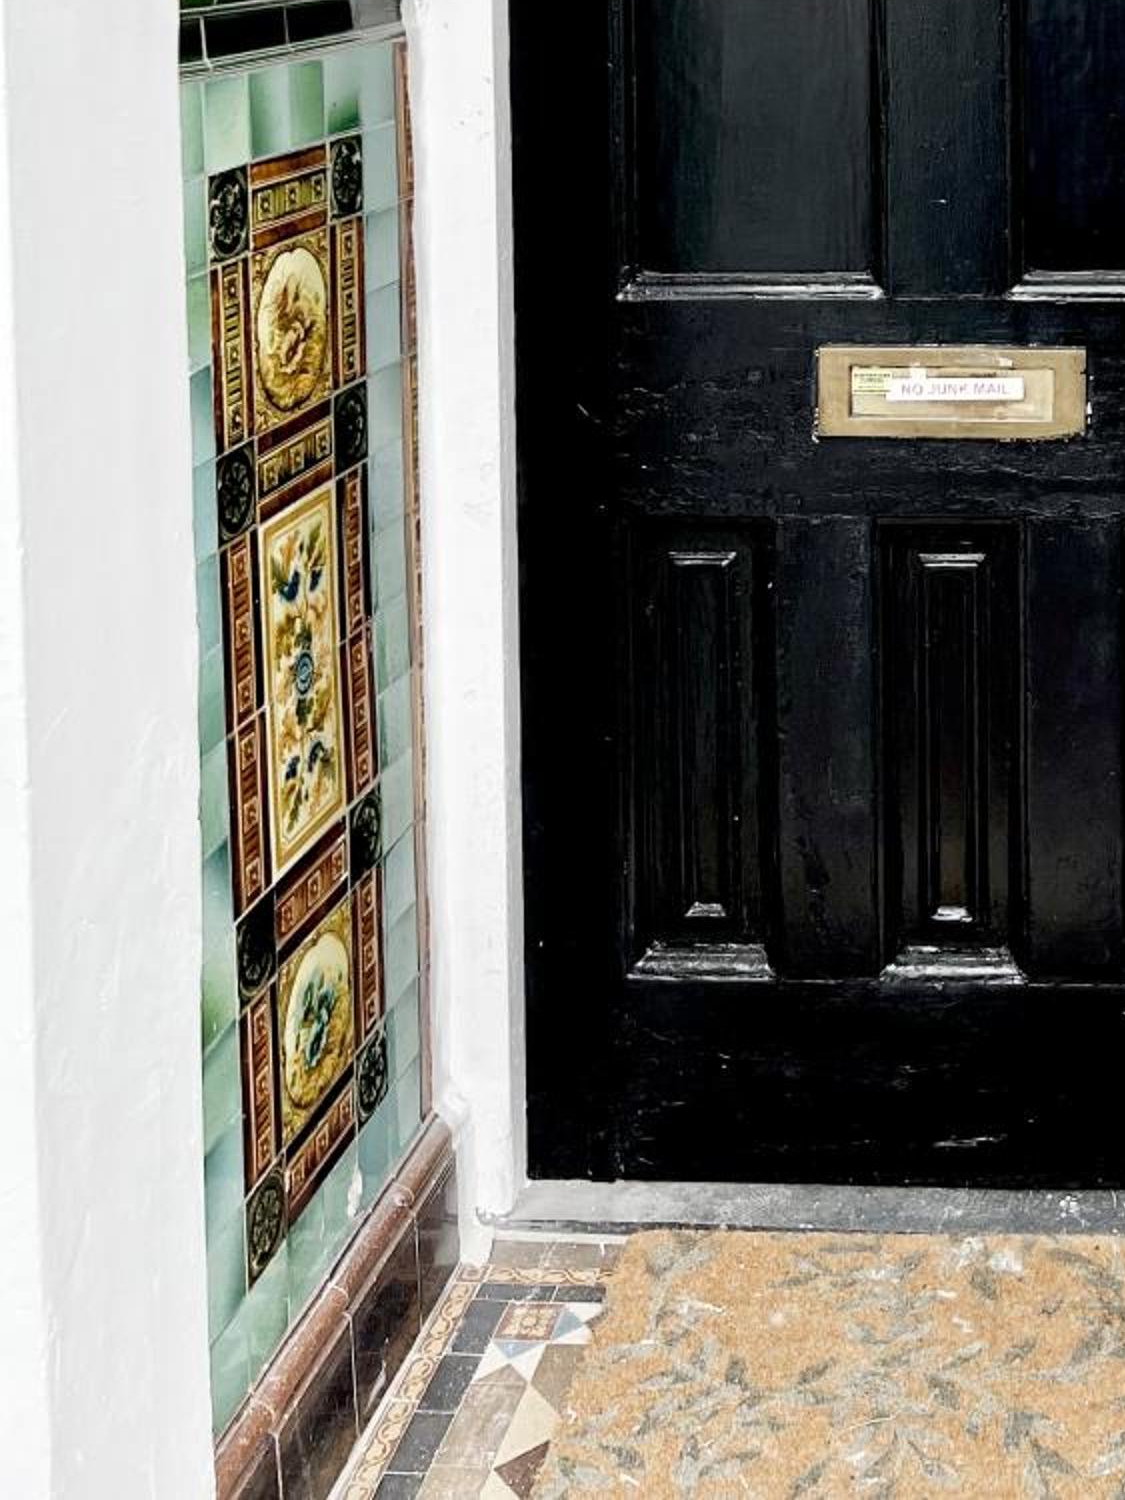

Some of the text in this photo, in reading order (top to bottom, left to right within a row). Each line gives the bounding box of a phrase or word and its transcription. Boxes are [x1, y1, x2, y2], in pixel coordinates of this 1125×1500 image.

[901, 383, 1009, 396] NO JUNK MAIL
